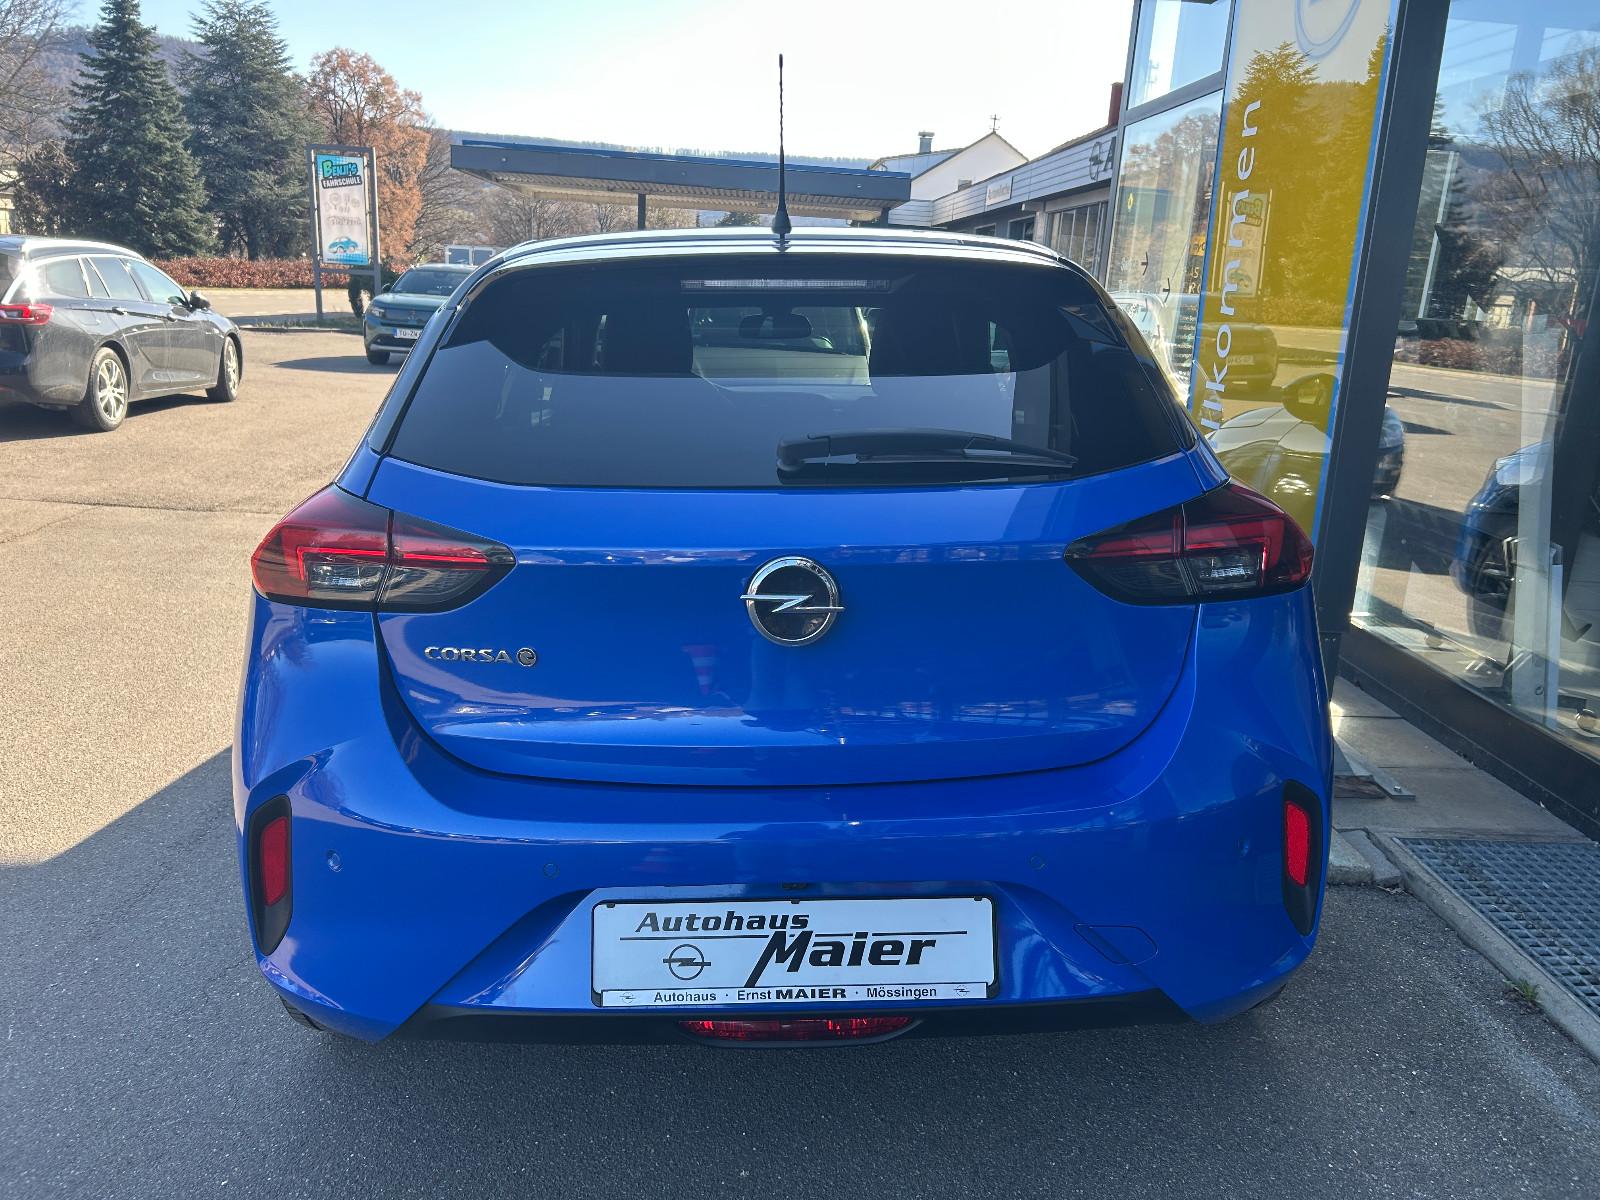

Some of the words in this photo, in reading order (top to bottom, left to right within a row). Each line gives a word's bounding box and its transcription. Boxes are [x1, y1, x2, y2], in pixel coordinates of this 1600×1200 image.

[322, 176, 361, 188] FAHRSCHULE
[1200, 100, 1262, 449] llkommen
[424, 646, 513, 664] CORSA
[635, 910, 809, 933] Autohaus
[744, 930, 937, 988] Maier
[653, 991, 717, 1003] Autohaus
[737, 989, 772, 1001] Ernst
[775, 988, 847, 1000] MAIER
[866, 986, 938, 1000] Mössingen
